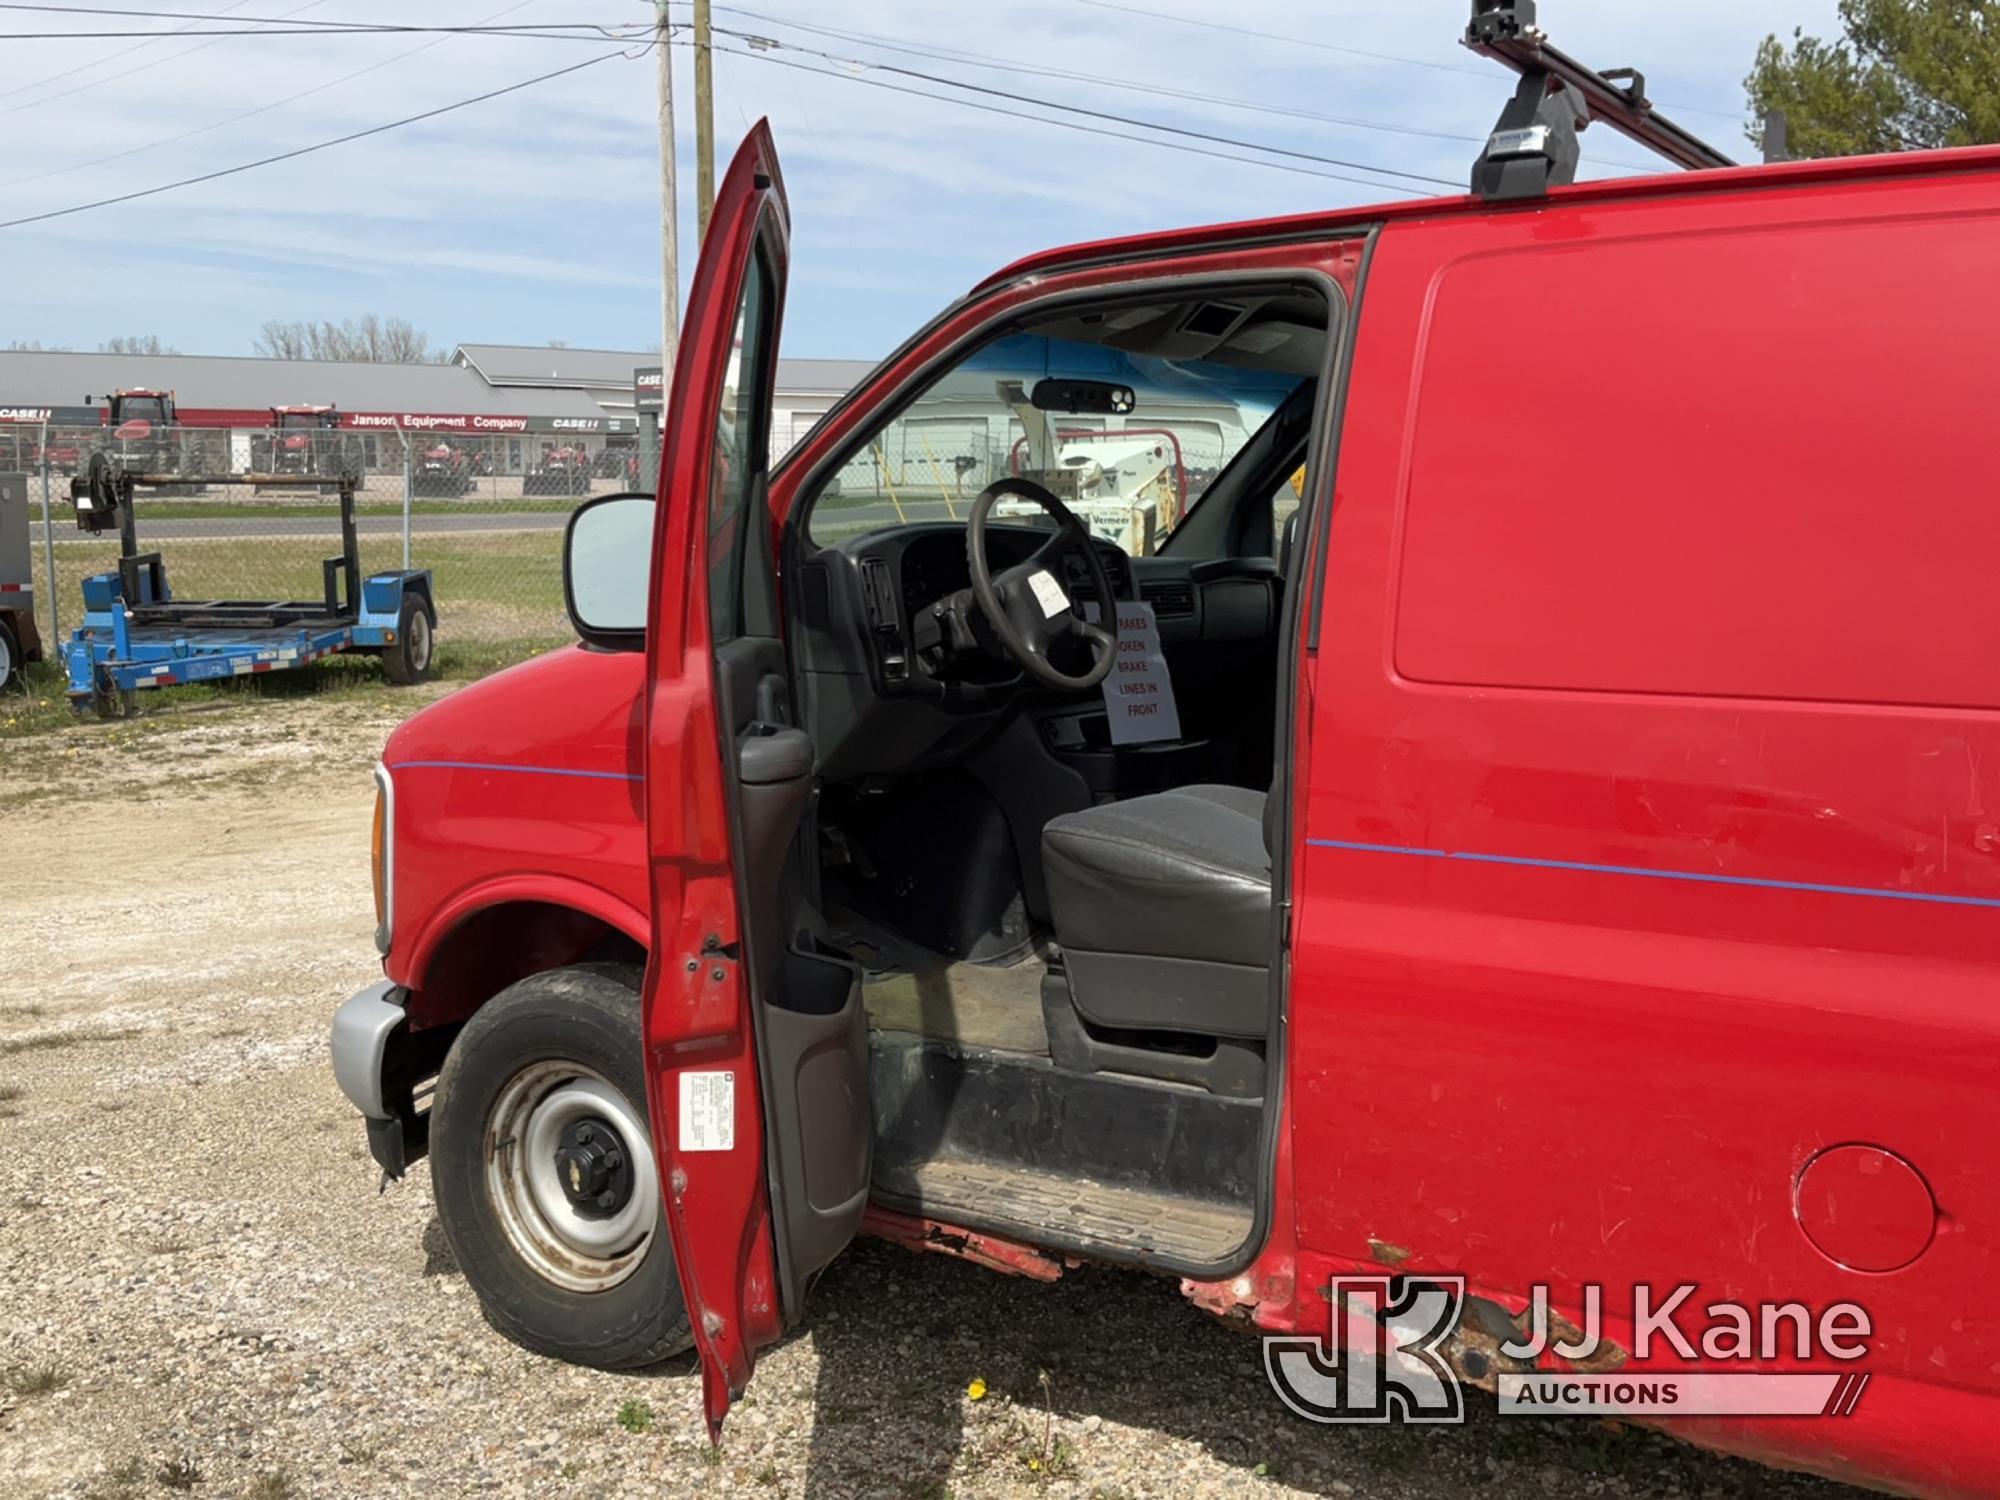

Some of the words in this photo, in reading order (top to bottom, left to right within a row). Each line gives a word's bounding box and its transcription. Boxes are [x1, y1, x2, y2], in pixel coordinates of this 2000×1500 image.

[637, 374, 661, 385] CASE
[351, 414, 396, 426] Janson
[403, 414, 466, 429] Equipment
[473, 416, 527, 430] Company
[1092, 515, 1130, 525] Vermeer
[1119, 617, 1148, 630] RAKES
[1116, 640, 1146, 652] OKEN
[1117, 661, 1148, 672] BRAKE
[1119, 682, 1145, 695] LINES
[1146, 682, 1158, 694] IN
[1127, 703, 1158, 717] FRONT
